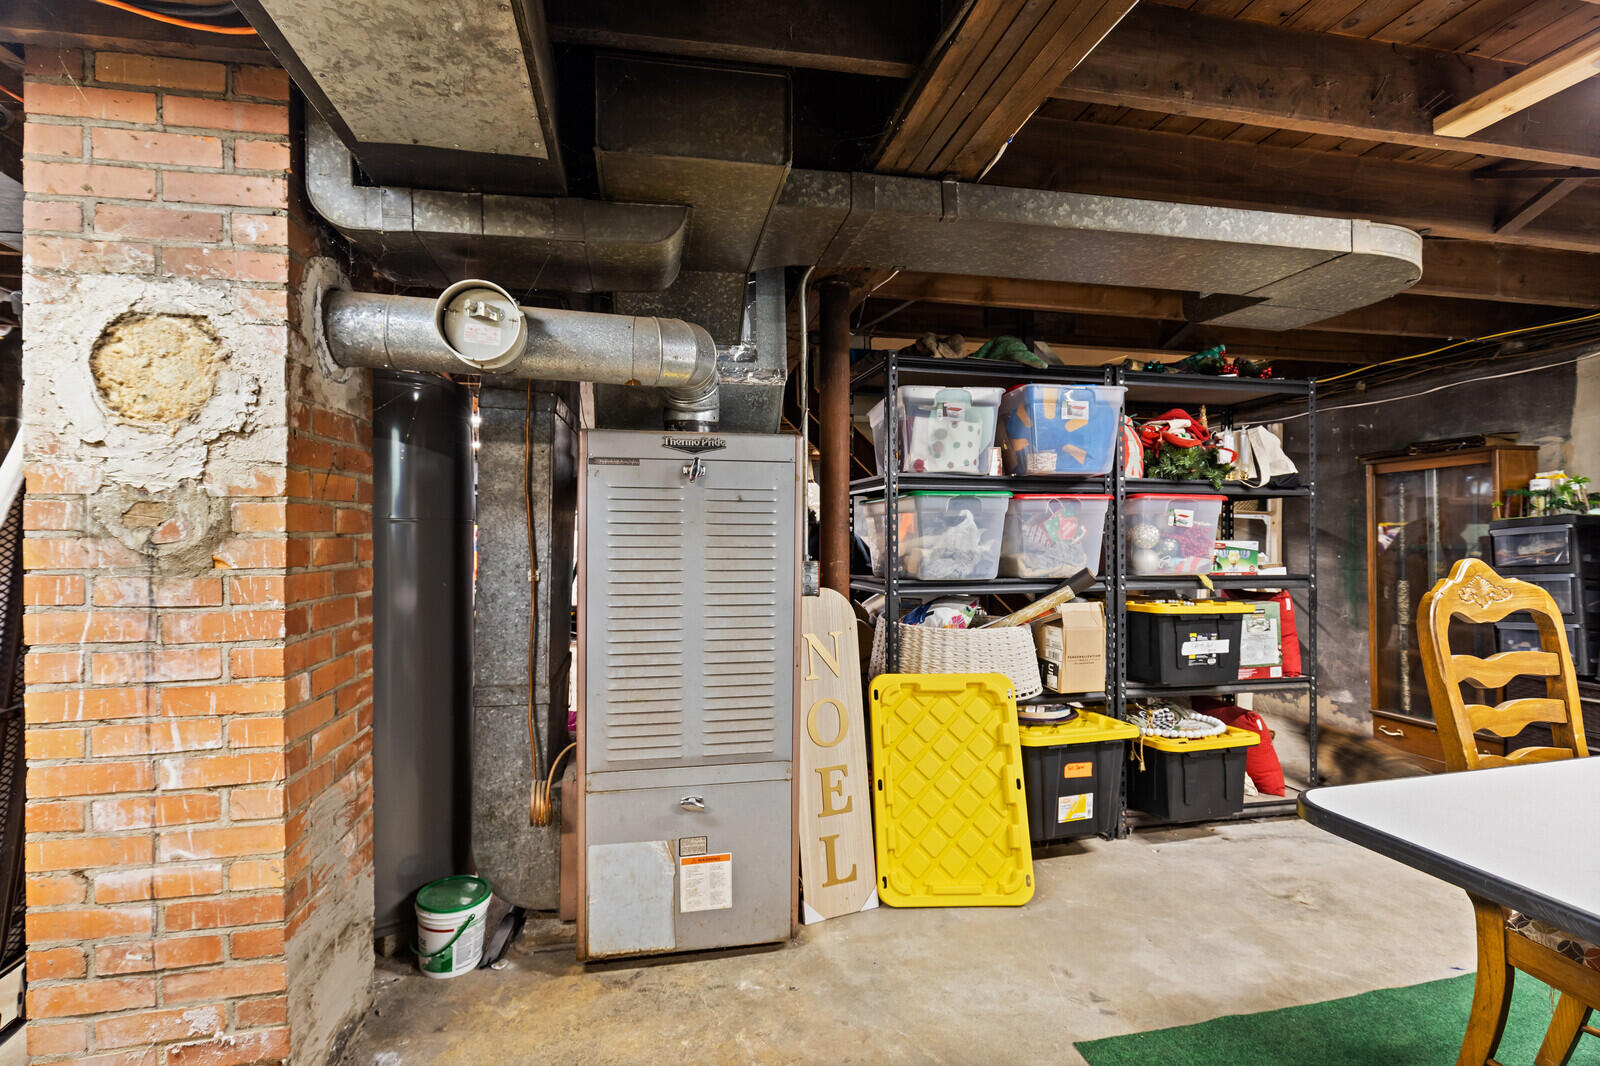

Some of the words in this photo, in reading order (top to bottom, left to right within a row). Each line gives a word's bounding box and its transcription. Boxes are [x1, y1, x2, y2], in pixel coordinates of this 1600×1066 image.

[663, 436, 701, 446] Thermo
[702, 438, 727, 447] Pride
[801, 630, 858, 888] NOEL
